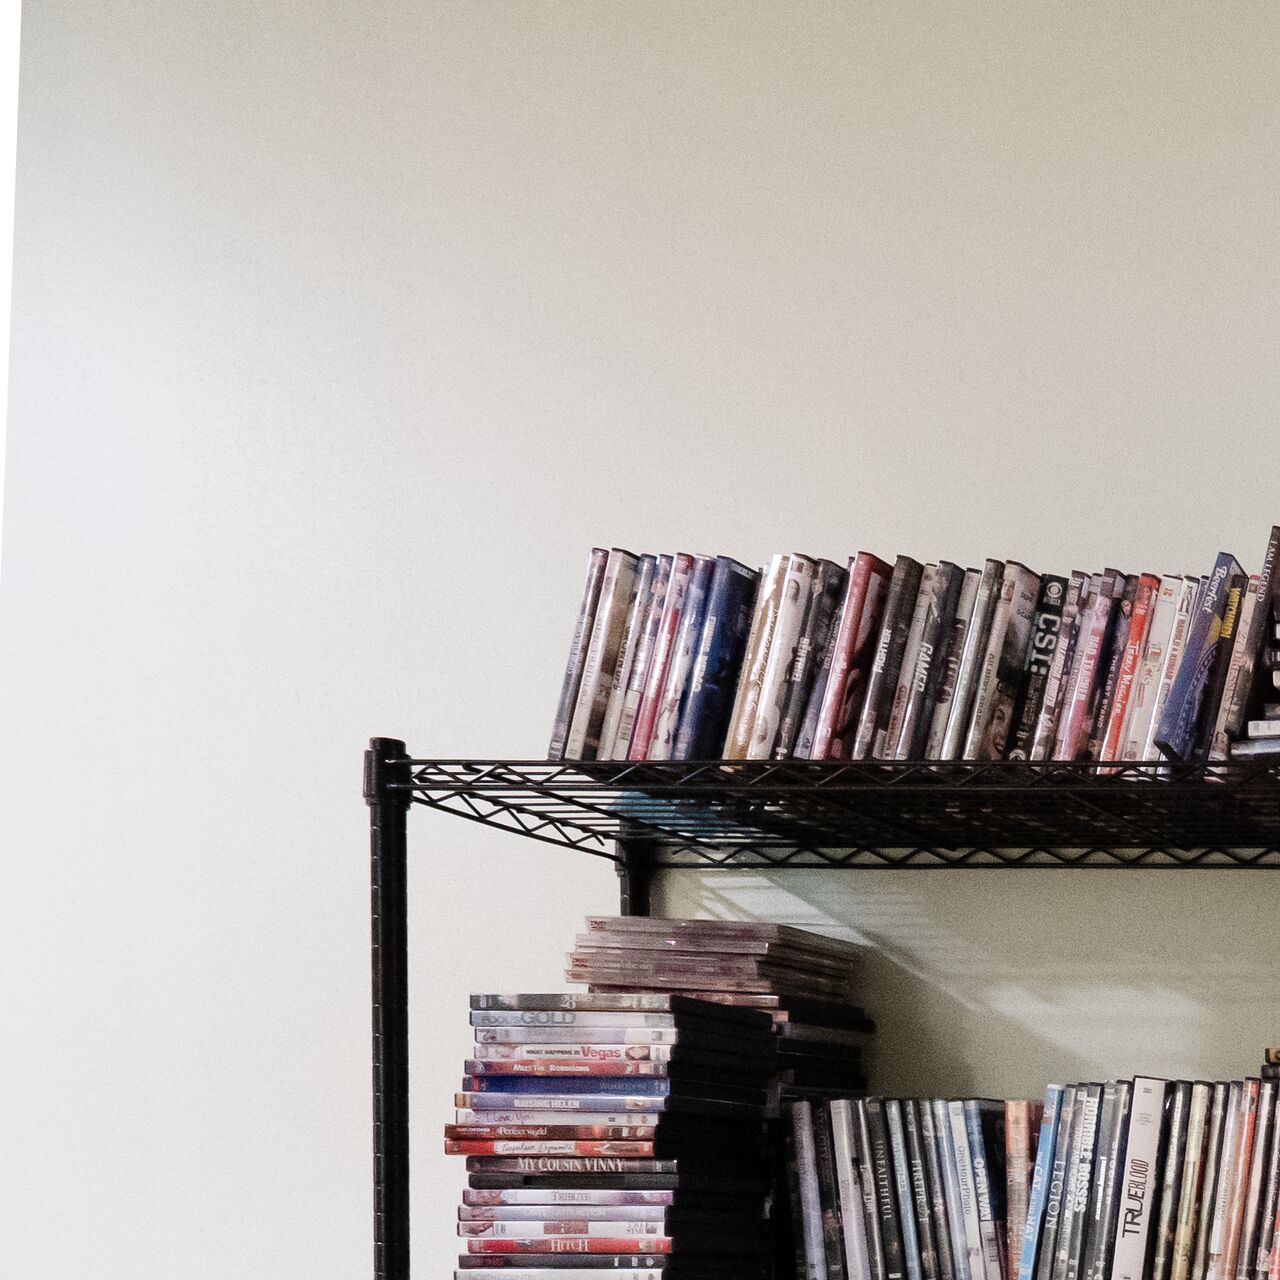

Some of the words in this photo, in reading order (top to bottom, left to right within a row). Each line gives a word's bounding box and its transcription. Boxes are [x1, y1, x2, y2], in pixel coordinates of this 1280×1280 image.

[1201, 565, 1228, 613] Beerfest
[874, 628, 893, 674] FIGHTER
[1030, 613, 1062, 677] CSI:
[580, 1046, 622, 1061] Vegas
[538, 1157, 581, 1172] COUSIN
[873, 1140, 893, 1220] UNFAITHFUL
[1045, 1159, 1066, 1229] LEGION
